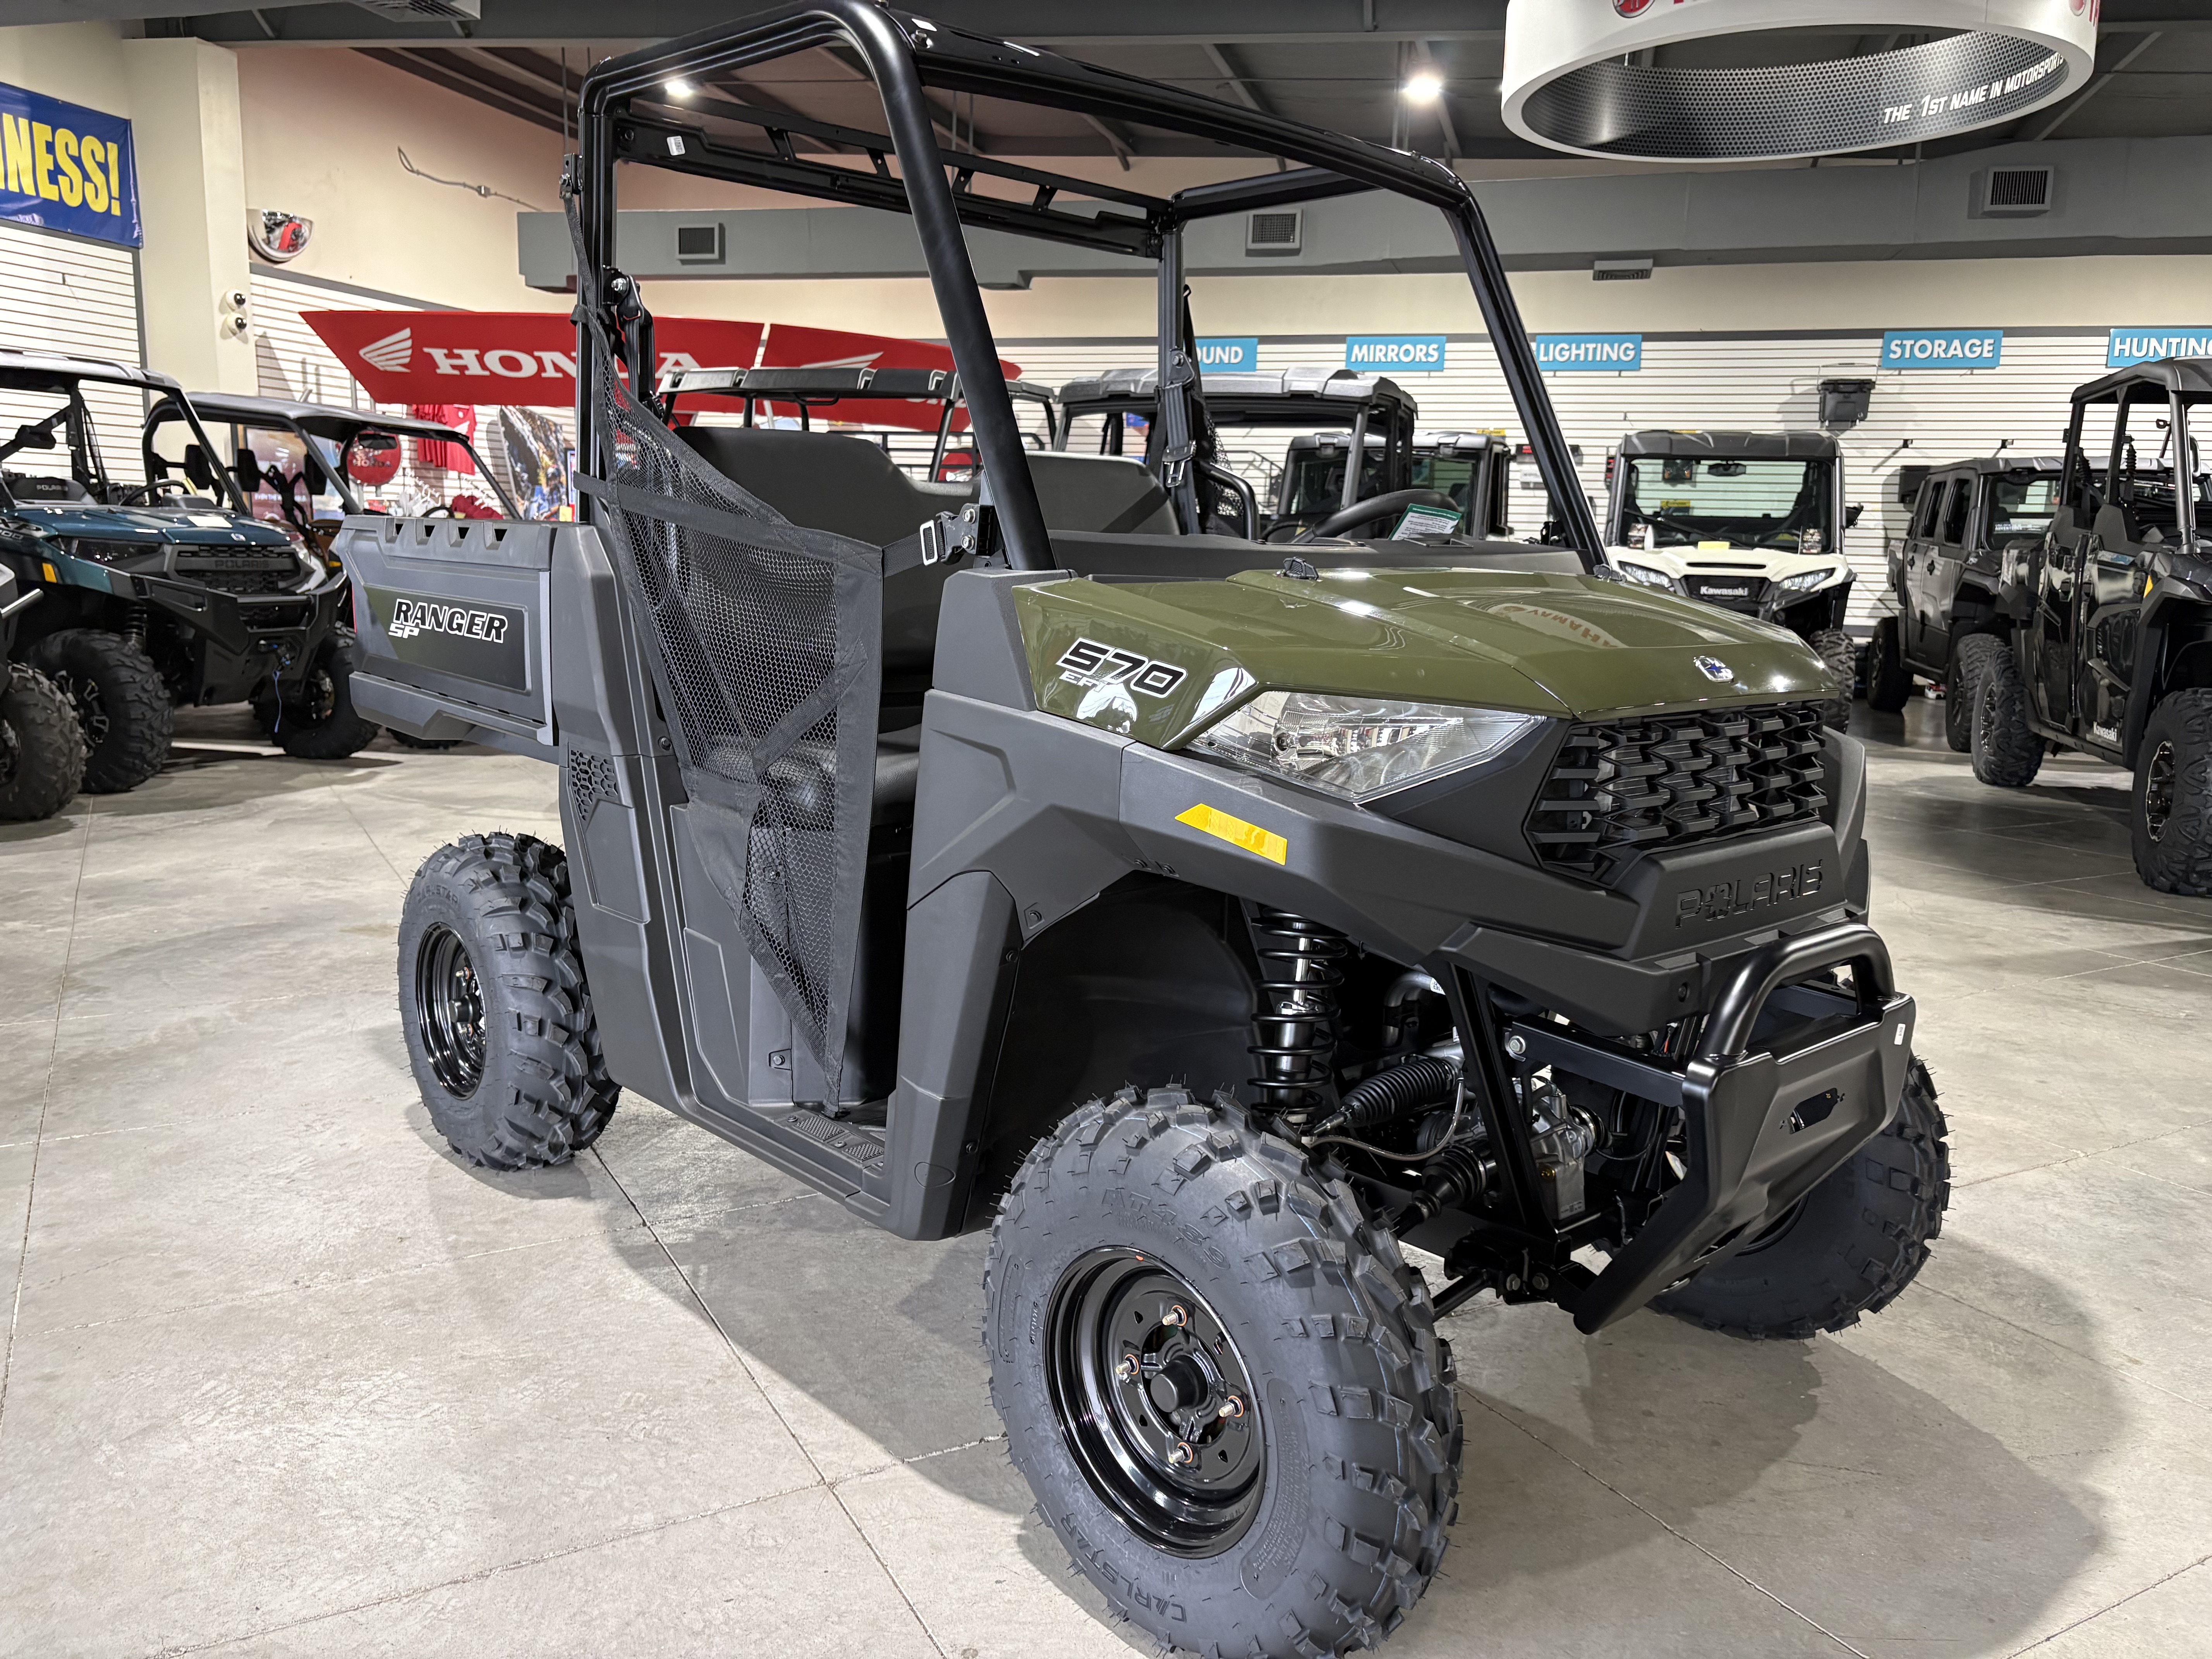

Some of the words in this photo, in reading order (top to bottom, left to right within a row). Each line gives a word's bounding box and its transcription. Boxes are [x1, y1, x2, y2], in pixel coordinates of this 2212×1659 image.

[1884, 103, 1912, 124] THE
[1922, 94, 1948, 117] 1ST
[1949, 85, 1989, 111] NAME
[1989, 79, 2003, 99] IN
[1350, 344, 1439, 363] MIRRORS
[1539, 342, 1636, 362] LIGHTING
[1889, 338, 1994, 359] STORAGE
[1700, 586, 1748, 597] Kawasaki
[388, 622, 420, 639] SP
[393, 598, 508, 644] RANGER
[1055, 637, 1188, 699] 570
[1059, 669, 1111, 693] EFI
[2093, 721, 2117, 742] Kawasaki
[1675, 859, 1823, 929] POLARIS
